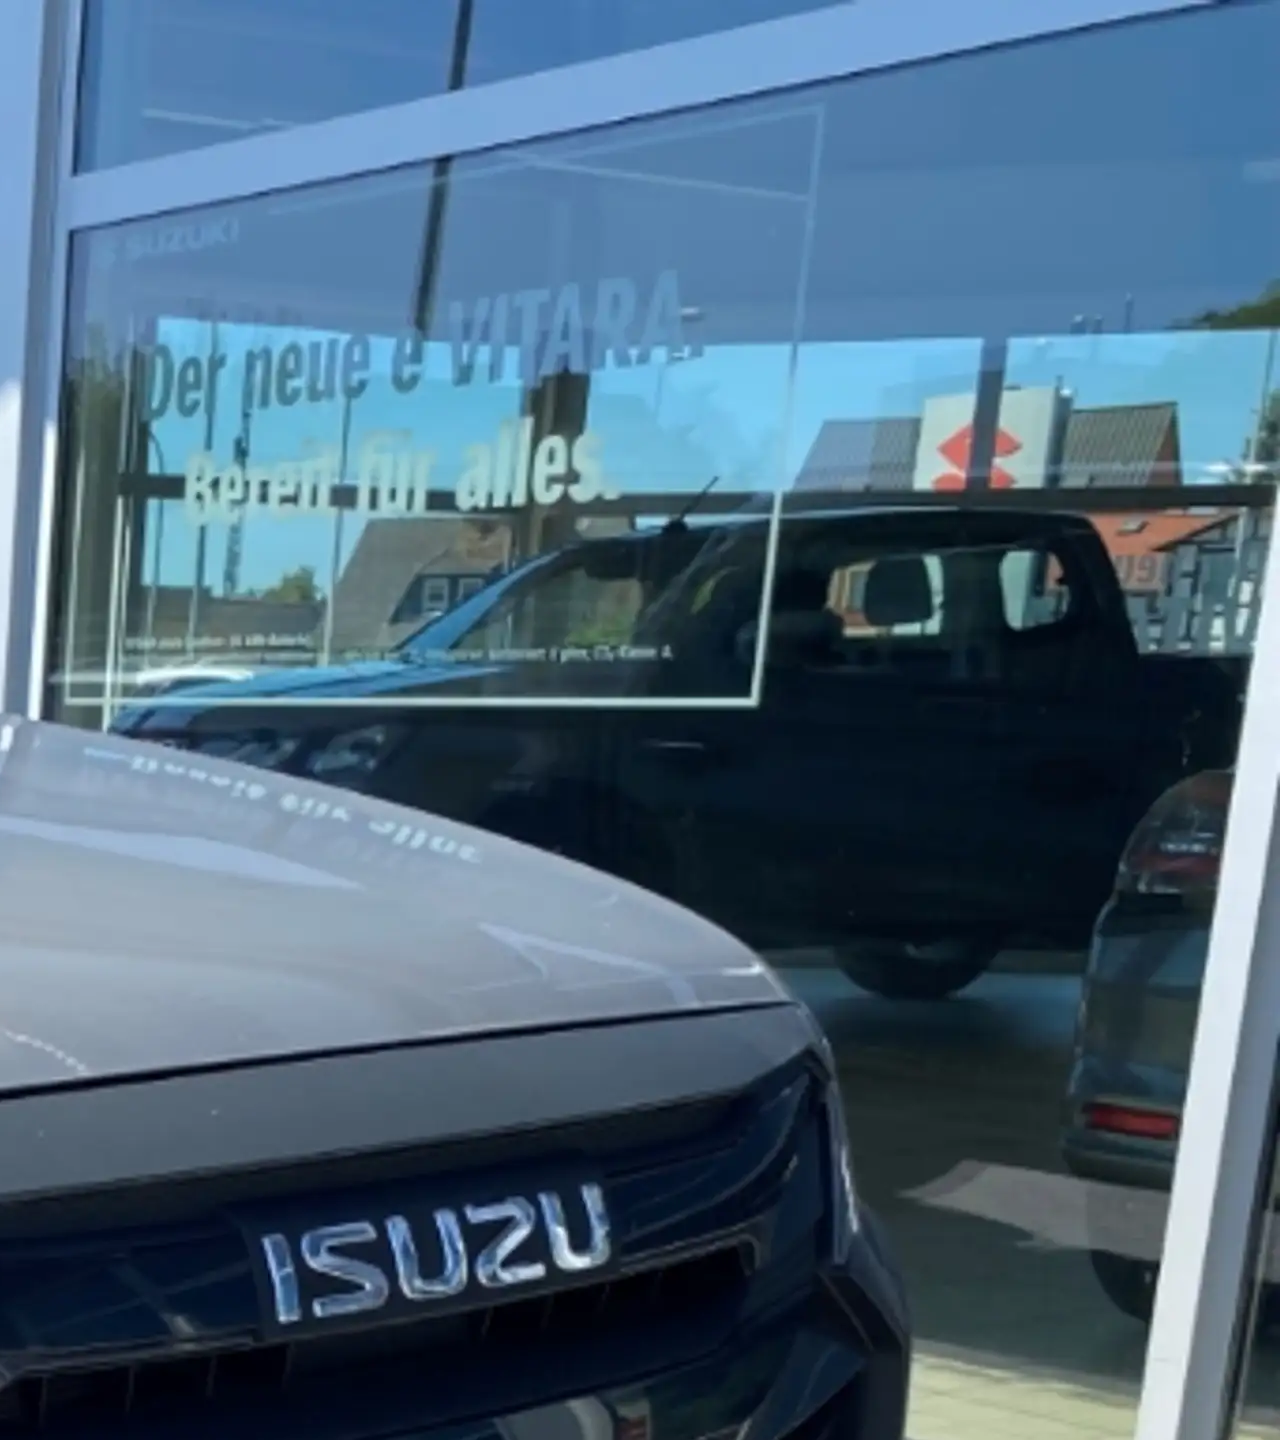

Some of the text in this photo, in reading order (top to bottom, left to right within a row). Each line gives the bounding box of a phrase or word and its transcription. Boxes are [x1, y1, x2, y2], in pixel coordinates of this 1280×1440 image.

[148, 343, 227, 420] Der
[245, 332, 371, 410] neue
[390, 330, 425, 393] e
[186, 416, 622, 525] Bereit für alles.
[261, 1183, 611, 1325] ISUZU
